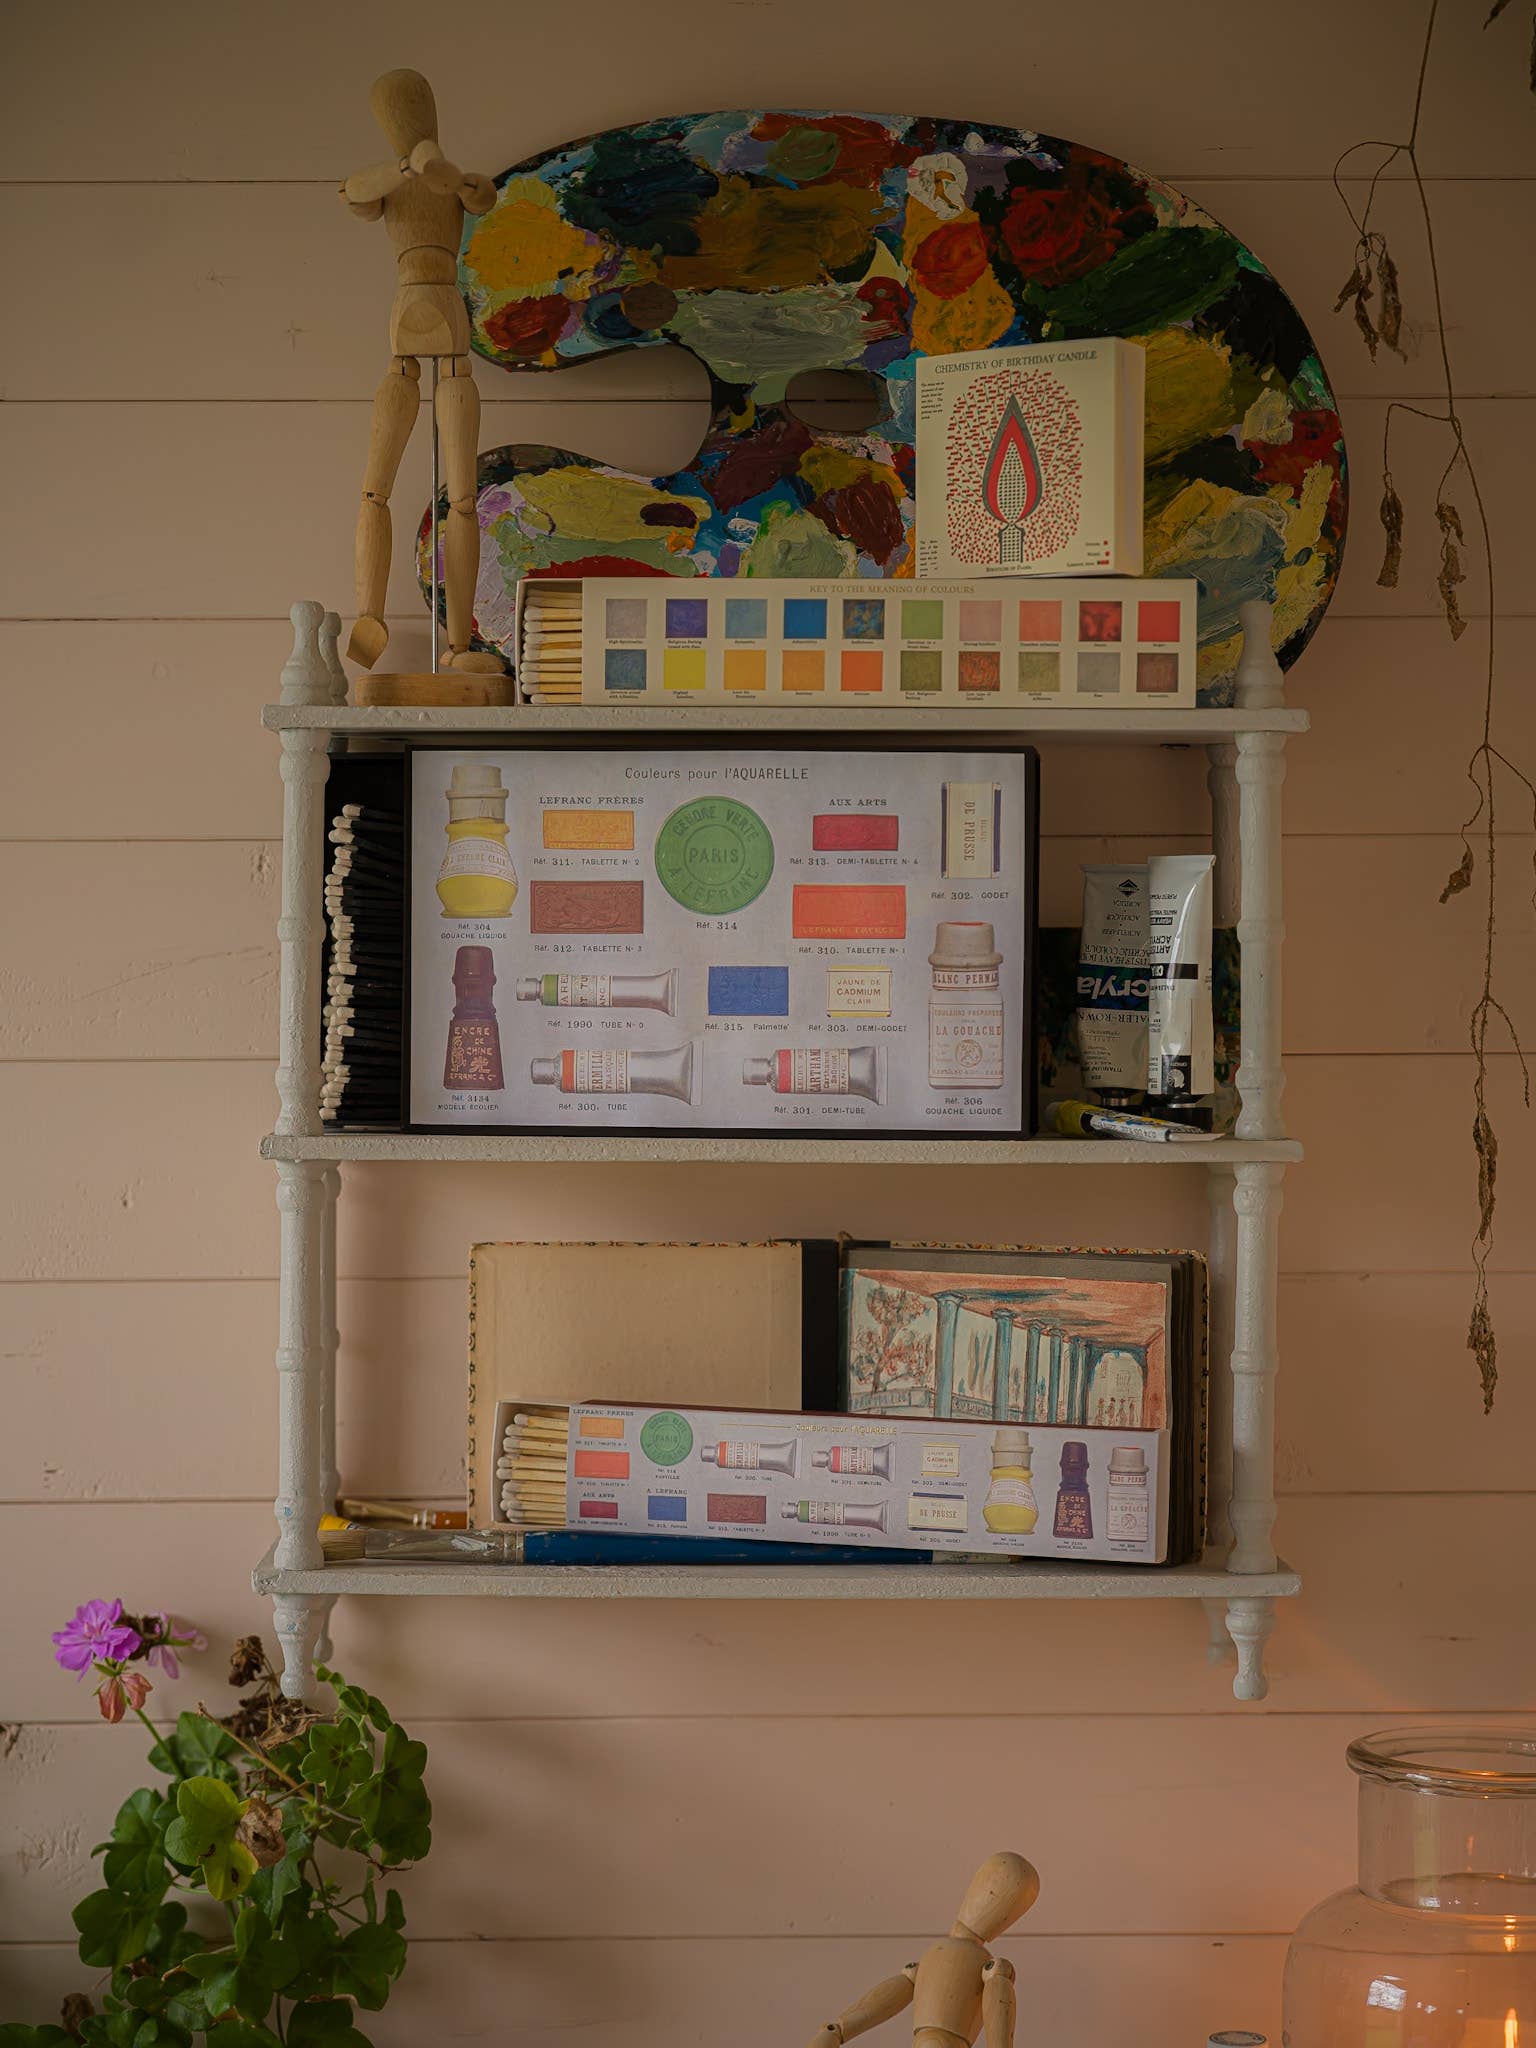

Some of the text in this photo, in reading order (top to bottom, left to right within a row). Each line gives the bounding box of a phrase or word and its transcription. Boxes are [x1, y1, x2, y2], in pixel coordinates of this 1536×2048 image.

[935, 350, 1098, 375] CHEMISTRY OF BIRTHDAY CANDLE
[810, 585, 975, 594] KEY TO THE MEANING OF COLOURS
[625, 767, 809, 781] Couleurs pour l'AQUARELLE
[540, 797, 592, 805] LEFRANC
[726, 809, 760, 842] VERTE
[964, 801, 976, 862] DE PRUSSE
[689, 848, 738, 864] PARIS
[717, 922, 737, 930] 314
[836, 988, 881, 996] CADMIUM
[568, 1021, 593, 1029] 1990
[455, 1027, 490, 1036] ENCRE
[936, 1026, 1002, 1036] LA GOUACHE
[466, 1047, 493, 1056] CHINE
[964, 1098, 983, 1106] 306
